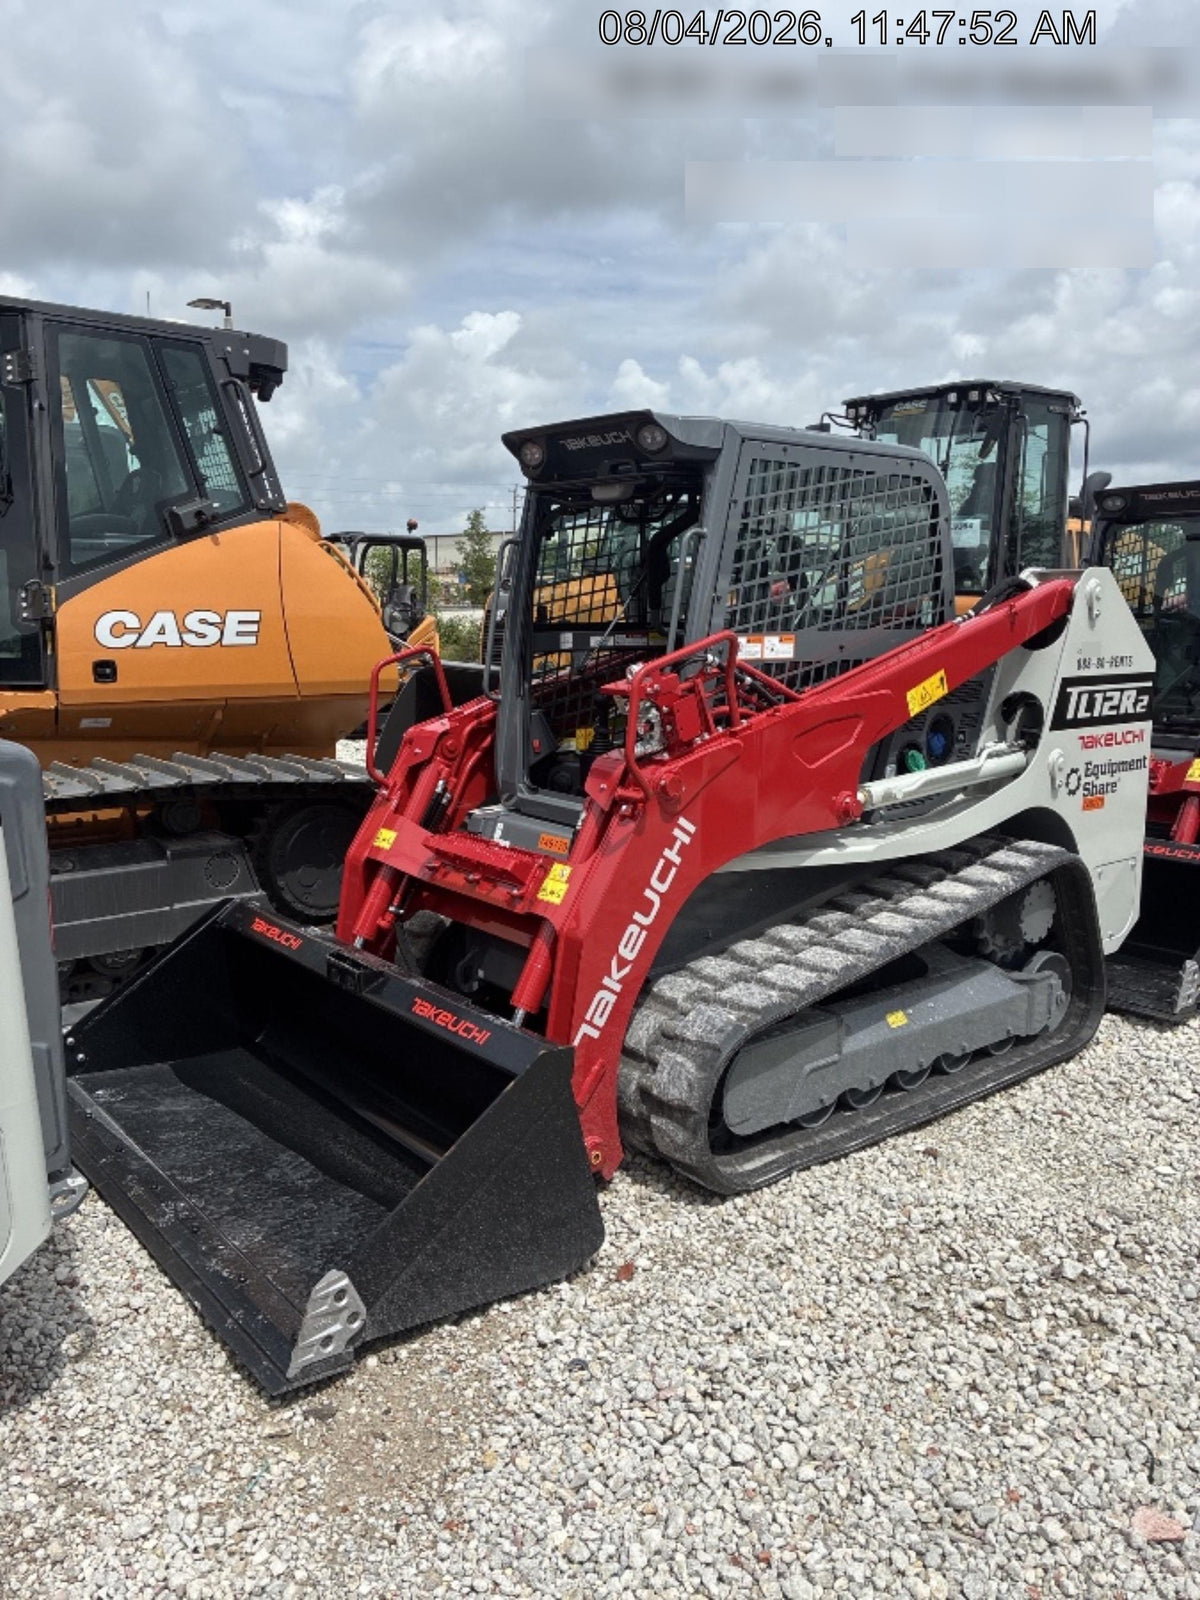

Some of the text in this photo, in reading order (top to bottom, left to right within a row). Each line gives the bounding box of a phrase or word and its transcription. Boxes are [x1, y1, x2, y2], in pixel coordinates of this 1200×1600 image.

[93, 610, 261, 650] CASE
[1065, 685, 1150, 721] TL12R2
[1084, 755, 1148, 780] Equipment
[1081, 780, 1118, 797] Share
